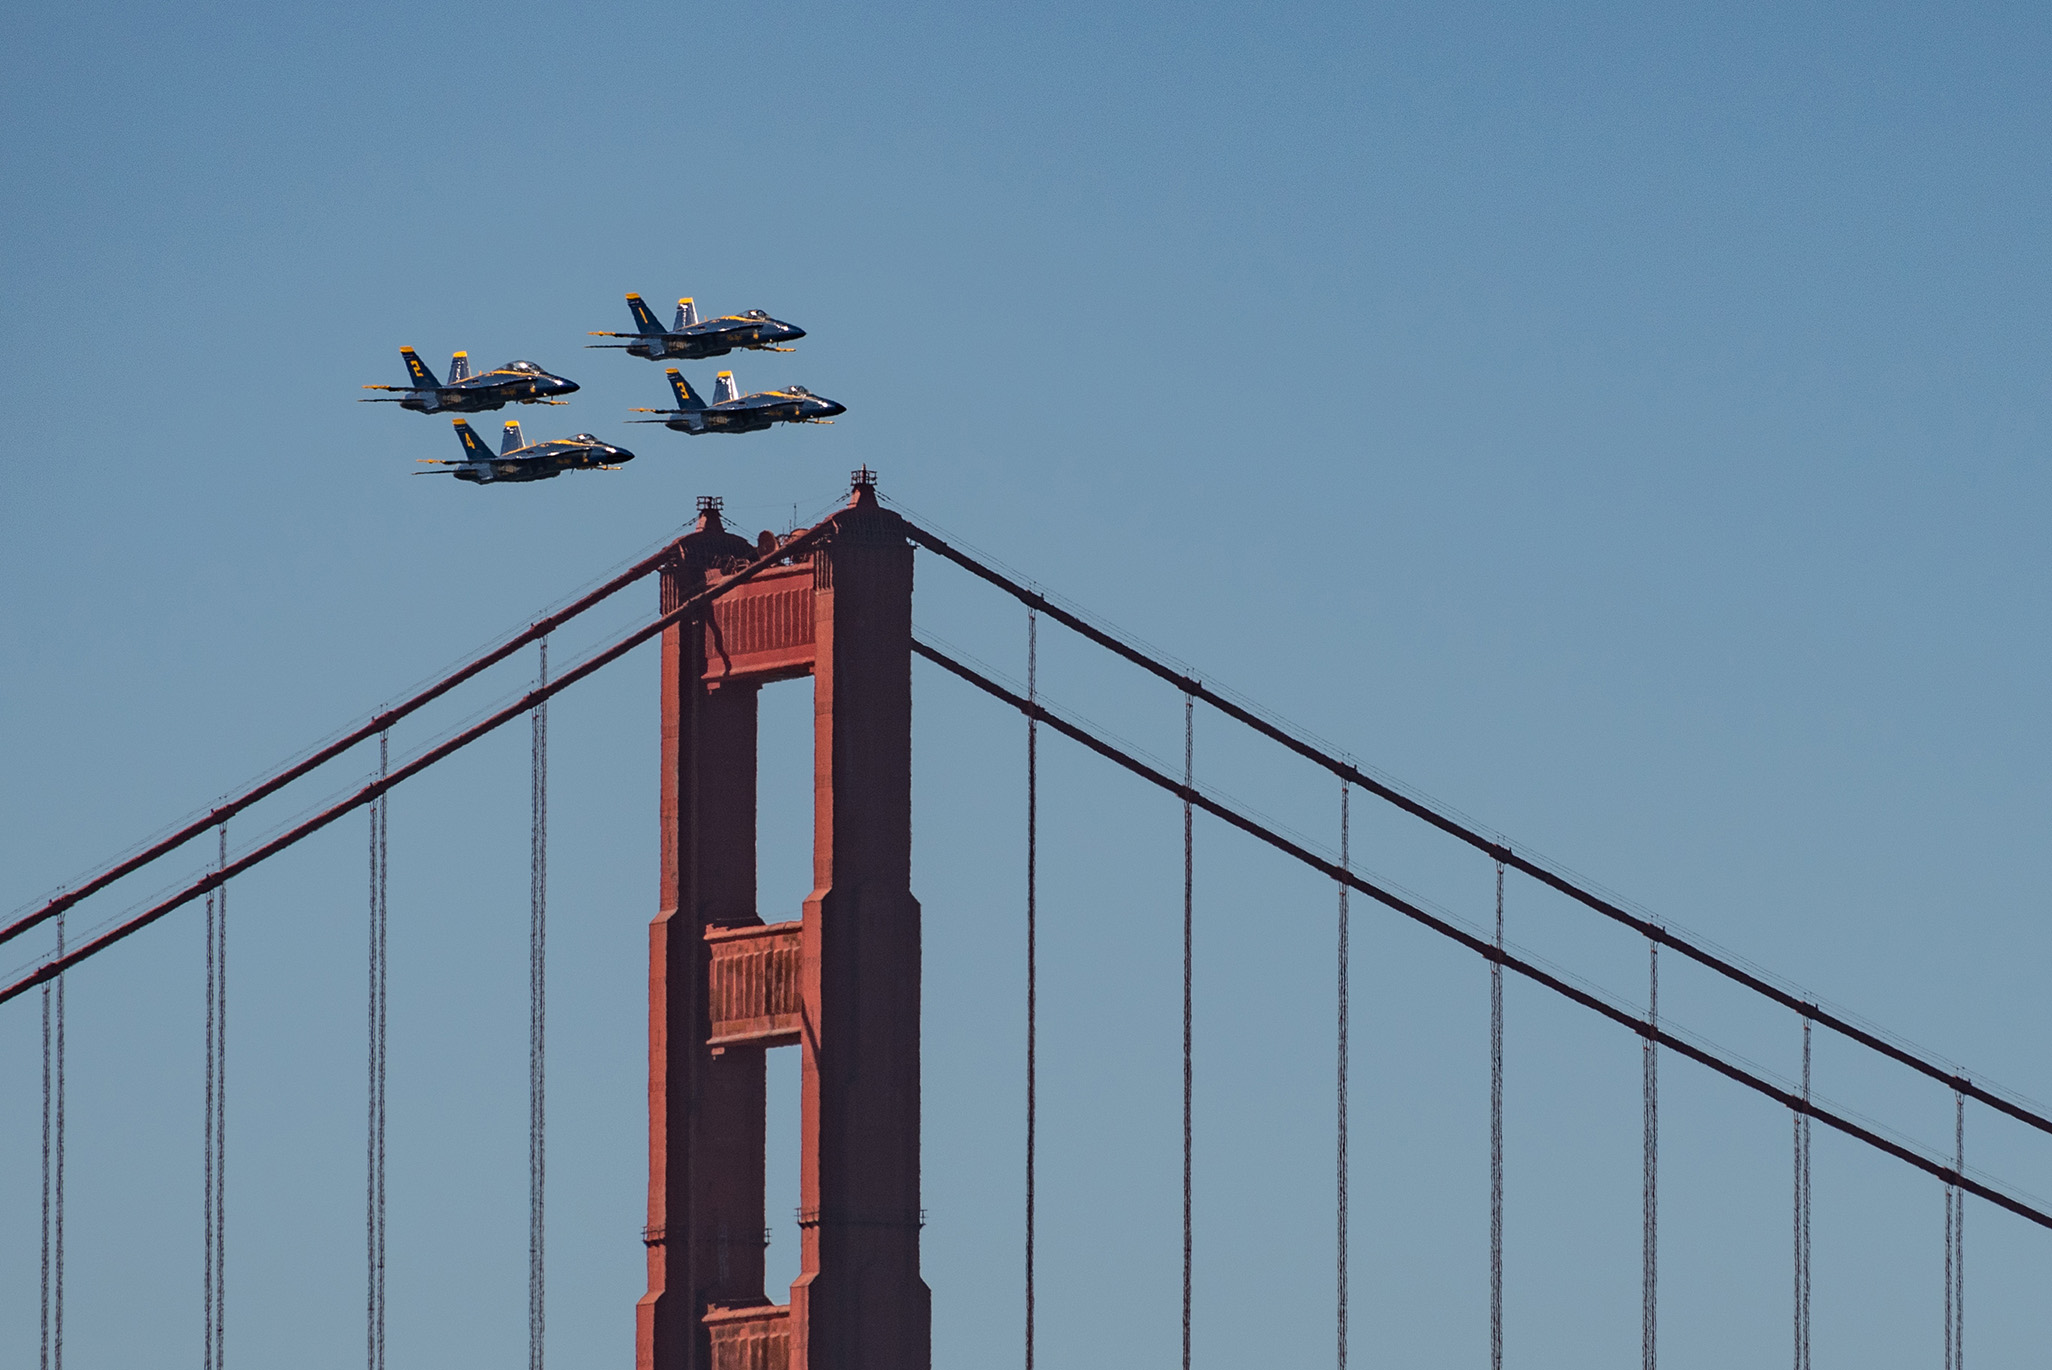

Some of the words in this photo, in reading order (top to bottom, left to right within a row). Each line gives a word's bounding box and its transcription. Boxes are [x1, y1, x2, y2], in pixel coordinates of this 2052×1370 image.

[638, 306, 648, 324] 1
[410, 360, 424, 377] 2
[676, 382, 690, 399] 3
[464, 432, 476, 450] 4
